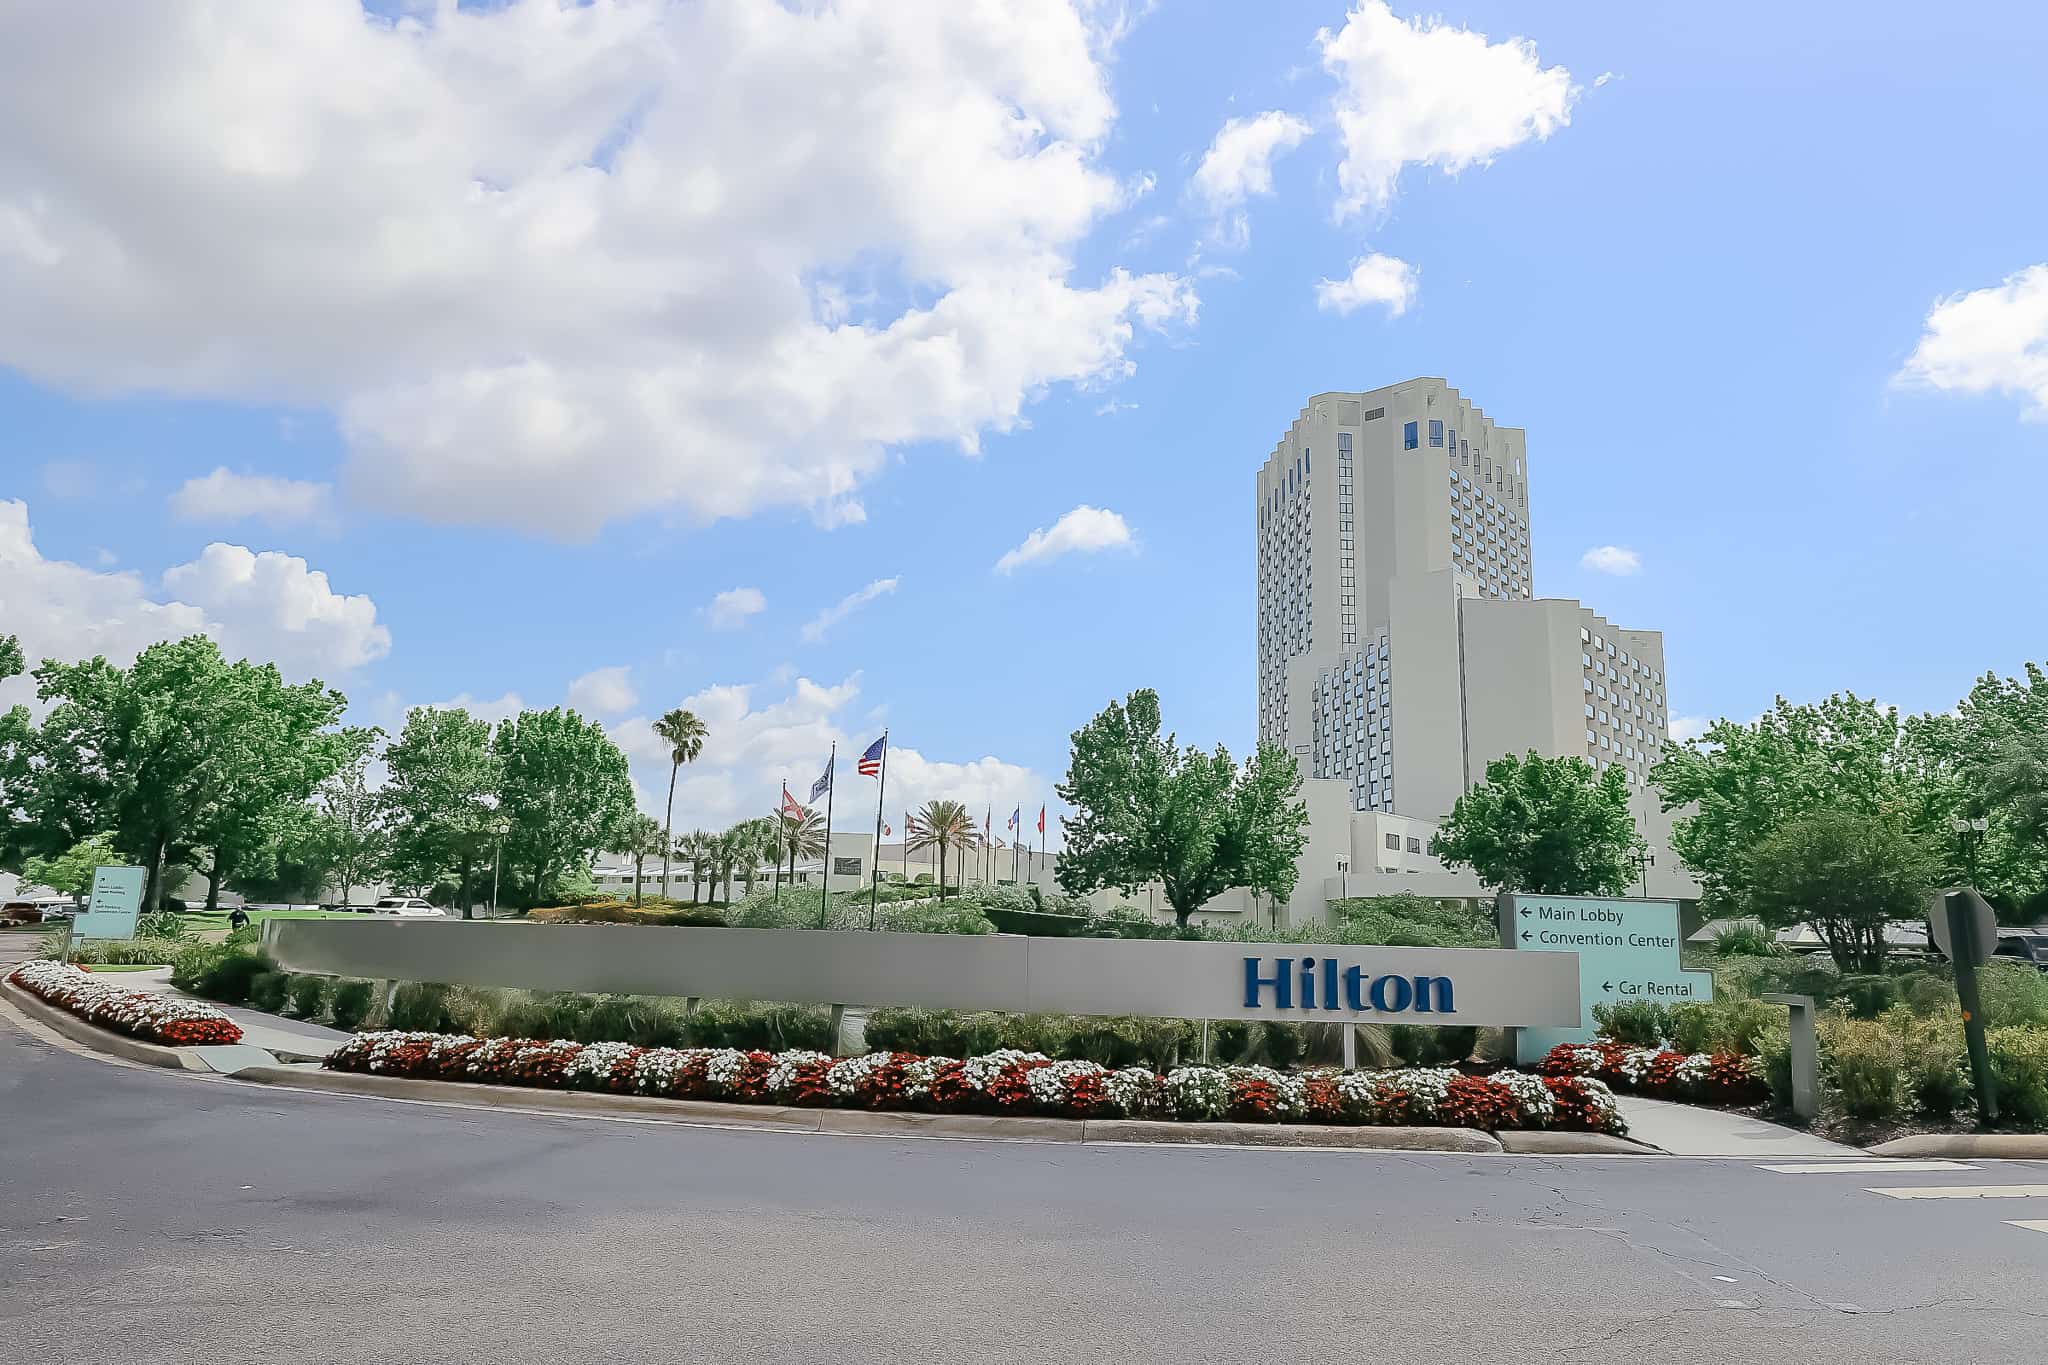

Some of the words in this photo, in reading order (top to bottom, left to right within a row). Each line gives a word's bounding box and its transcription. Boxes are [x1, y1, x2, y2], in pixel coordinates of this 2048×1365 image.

[1539, 907, 1575, 921] Main
[1581, 908, 1624, 926] Lobby
[1540, 930, 1623, 946] Convention
[1629, 933, 1676, 948] Center
[1243, 957, 1457, 1013] Hilton
[1619, 981, 1643, 995] Car
[1648, 982, 1693, 996] Rental
